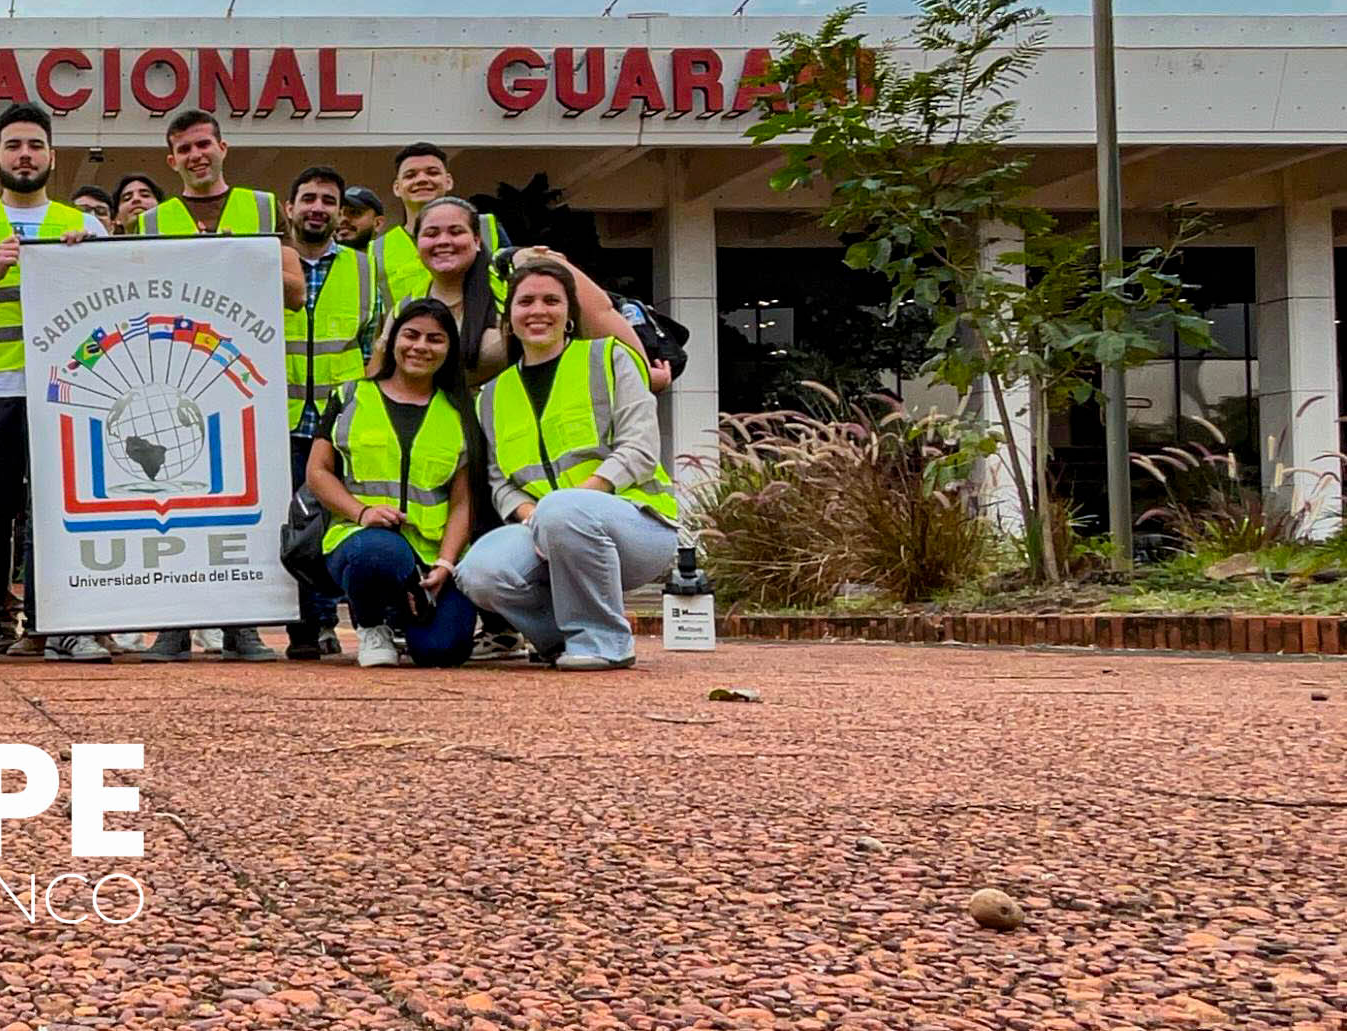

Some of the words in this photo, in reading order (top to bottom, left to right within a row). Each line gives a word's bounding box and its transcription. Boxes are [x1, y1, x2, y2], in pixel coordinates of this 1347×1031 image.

[32, 280, 140, 353] SABIDURIA
[148, 279, 173, 299] ES
[181, 282, 276, 345] LIBERTAD
[68, 573, 150, 588] Universidad
[153, 571, 206, 585] Privada
[209, 570, 229, 582] del
[231, 568, 264, 582] Este
